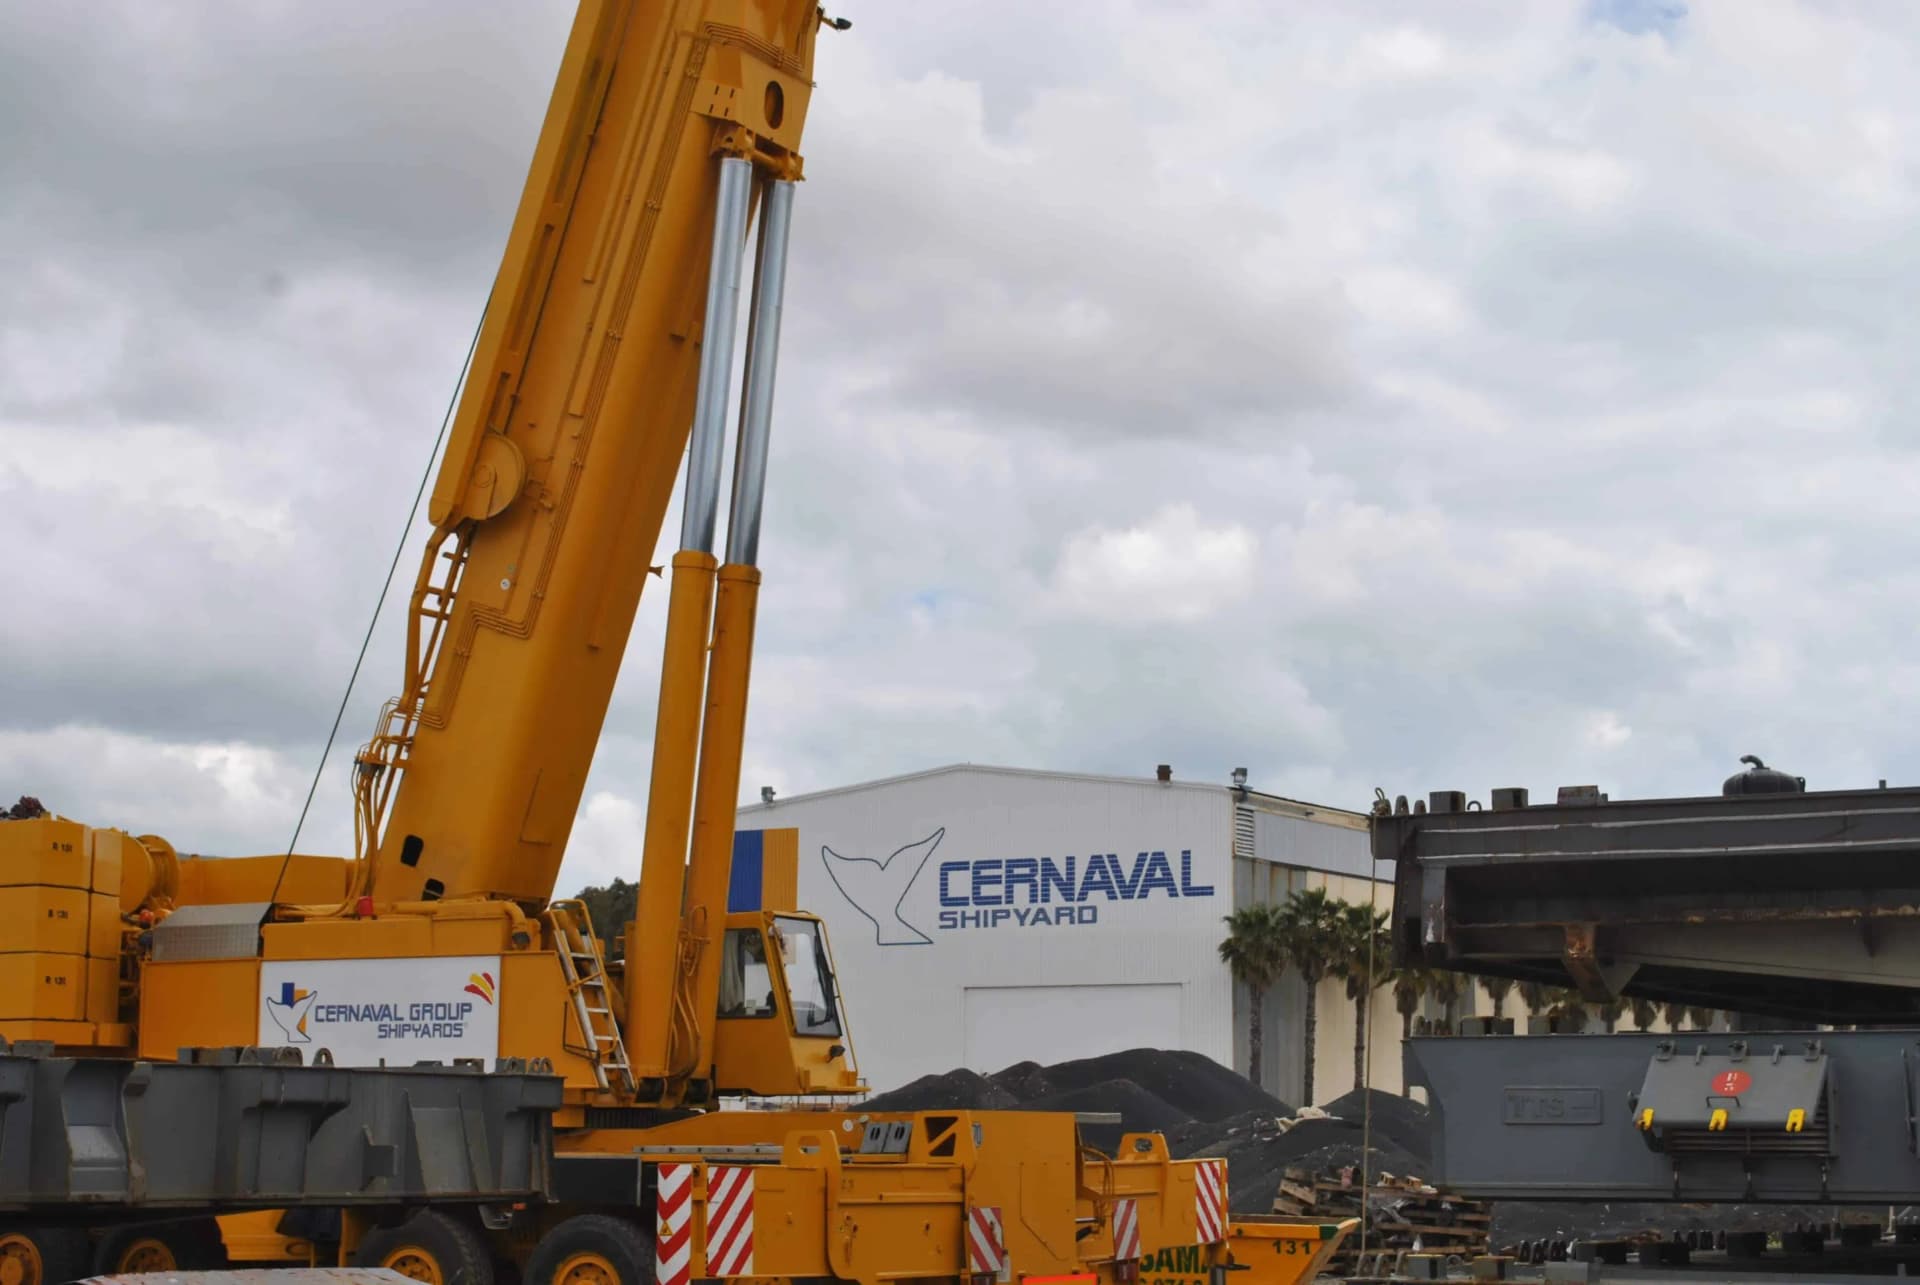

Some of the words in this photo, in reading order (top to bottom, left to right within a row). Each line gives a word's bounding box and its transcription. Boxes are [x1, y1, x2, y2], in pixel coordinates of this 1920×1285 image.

[939, 850, 1214, 906] CERNAVAL
[939, 905, 1098, 930] SHIPYARD
[314, 1003, 404, 1023] CERNAVAL
[409, 1002, 473, 1022] GROUP
[377, 1022, 464, 1039] SHIPYARDS
[1272, 1239, 1311, 1255] 131
